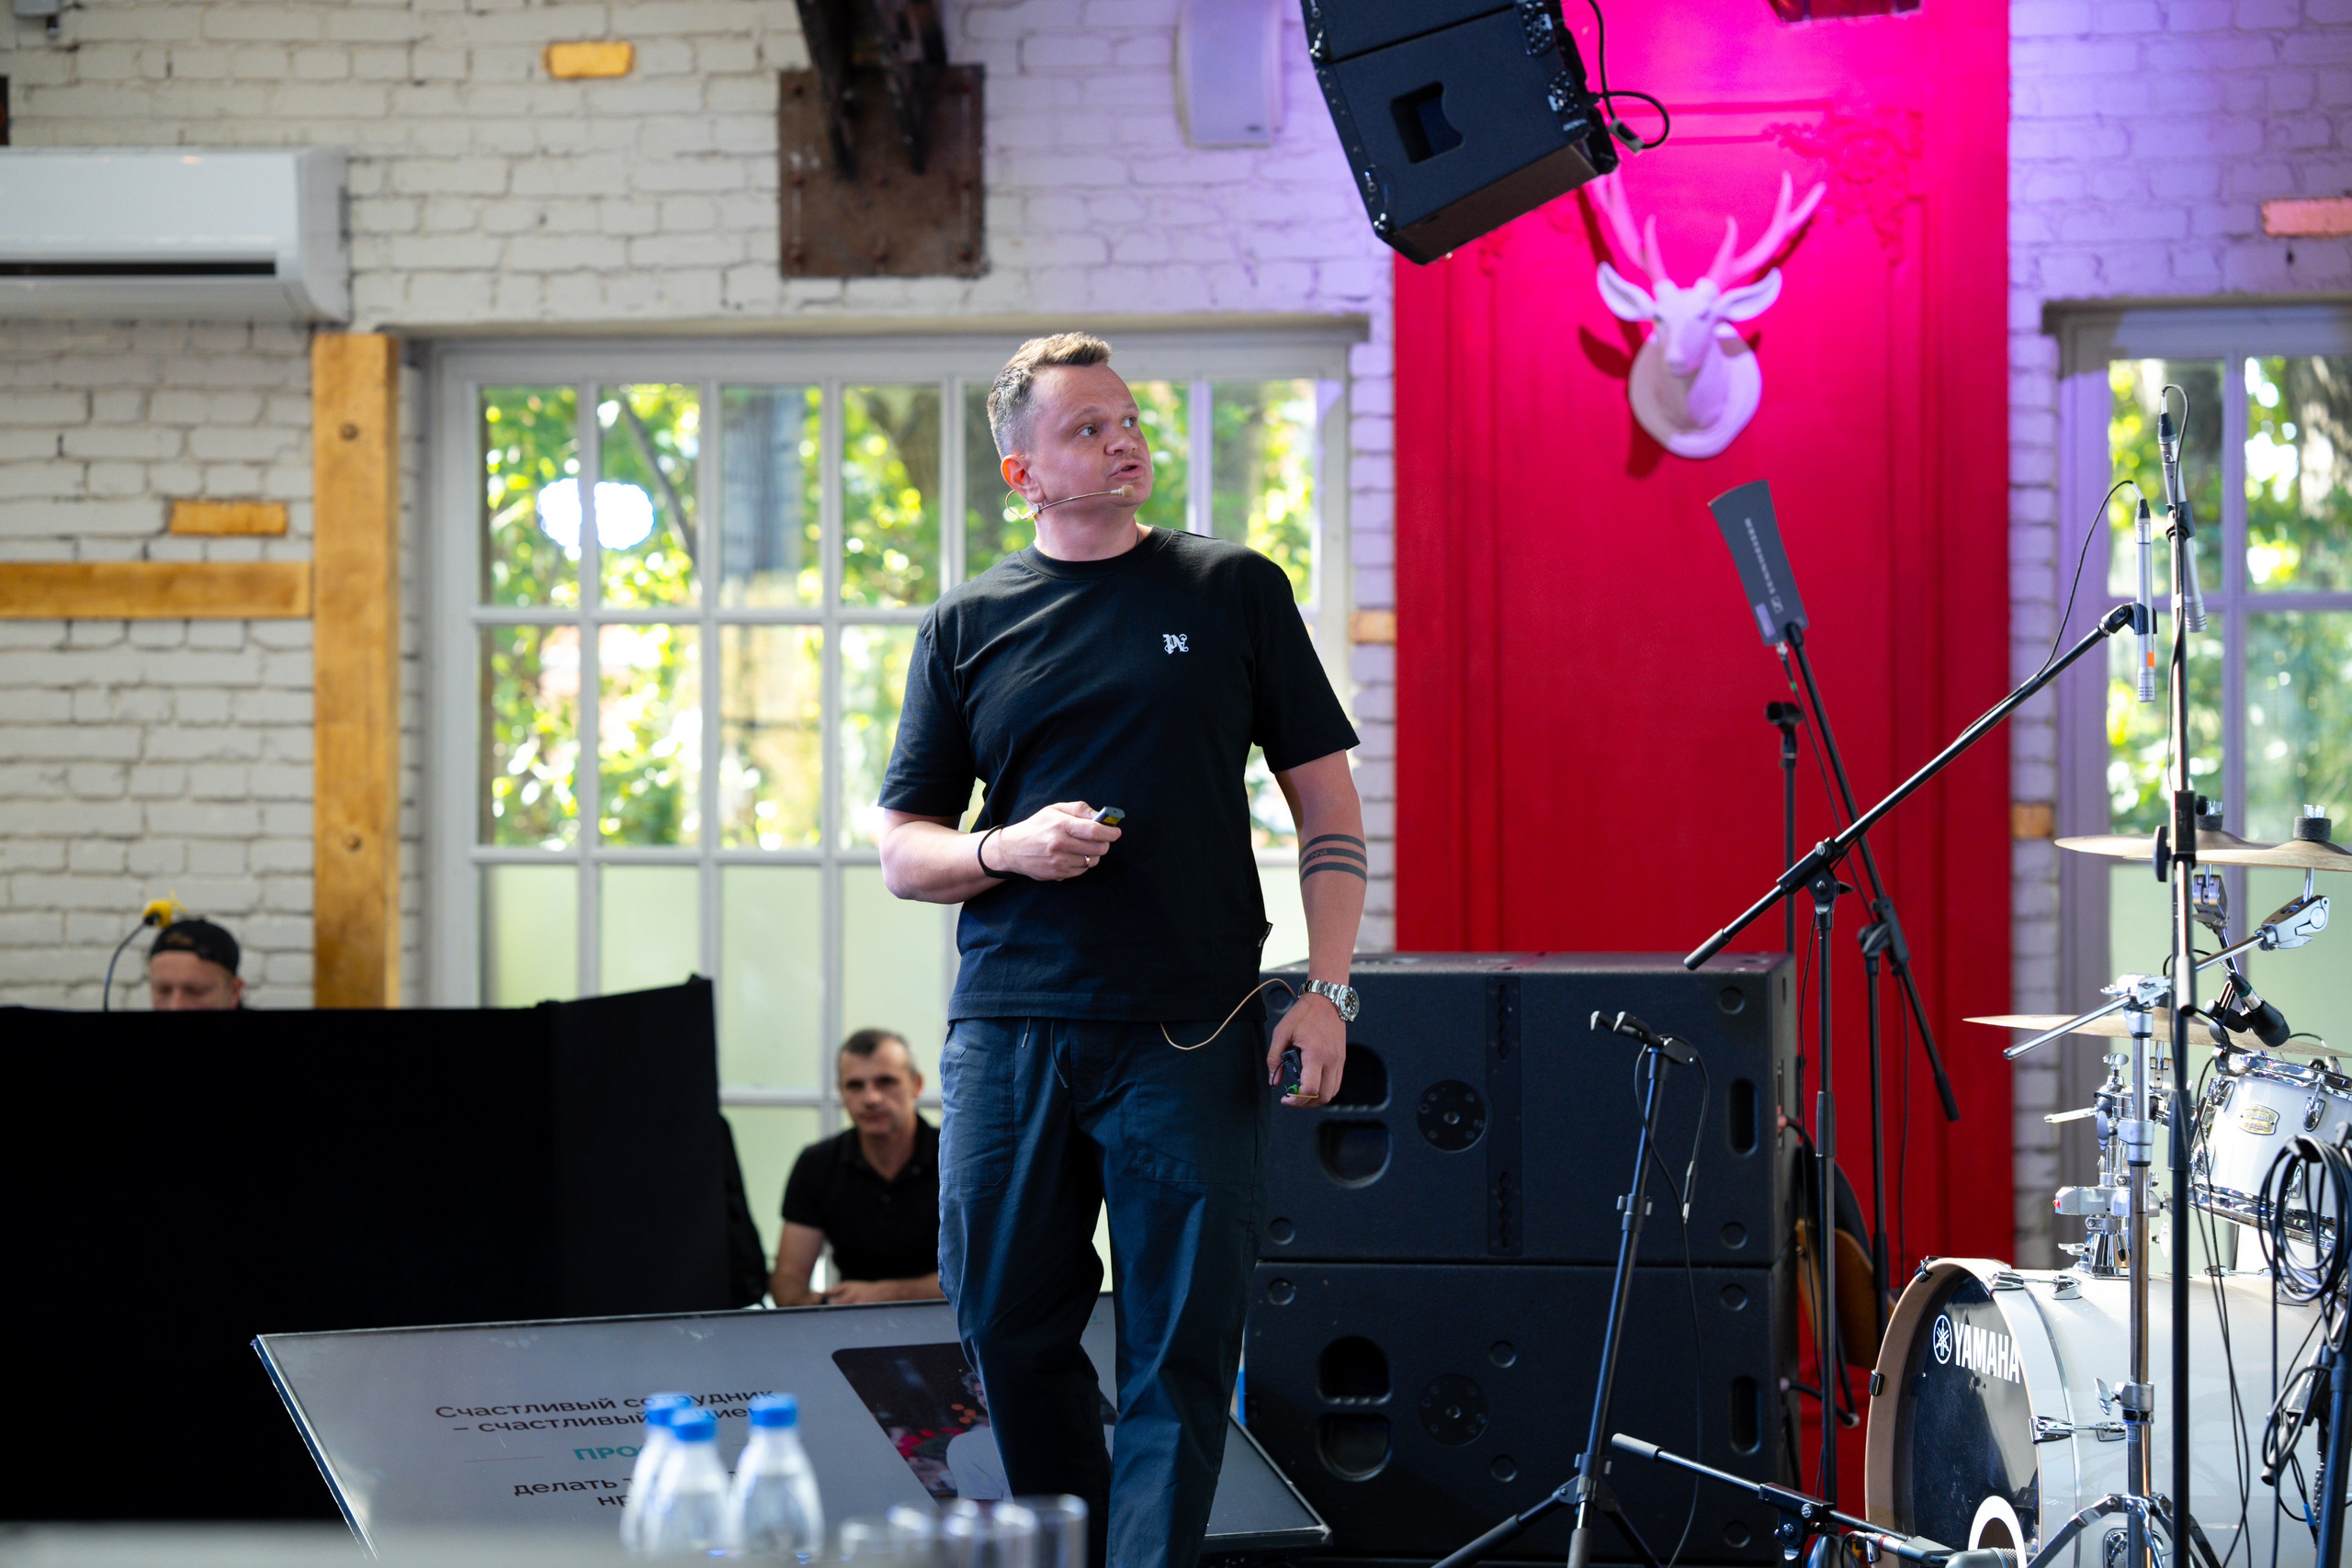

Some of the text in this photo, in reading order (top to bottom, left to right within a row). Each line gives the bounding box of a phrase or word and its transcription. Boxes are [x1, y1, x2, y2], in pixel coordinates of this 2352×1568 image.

[1953, 1321, 2020, 1384] YAMAHA
[435, 1397, 617, 1418] Счастливый
[478, 1411, 650, 1432] счастливый
[572, 1445, 644, 1461] ПРО
[513, 1479, 618, 1497] делать
